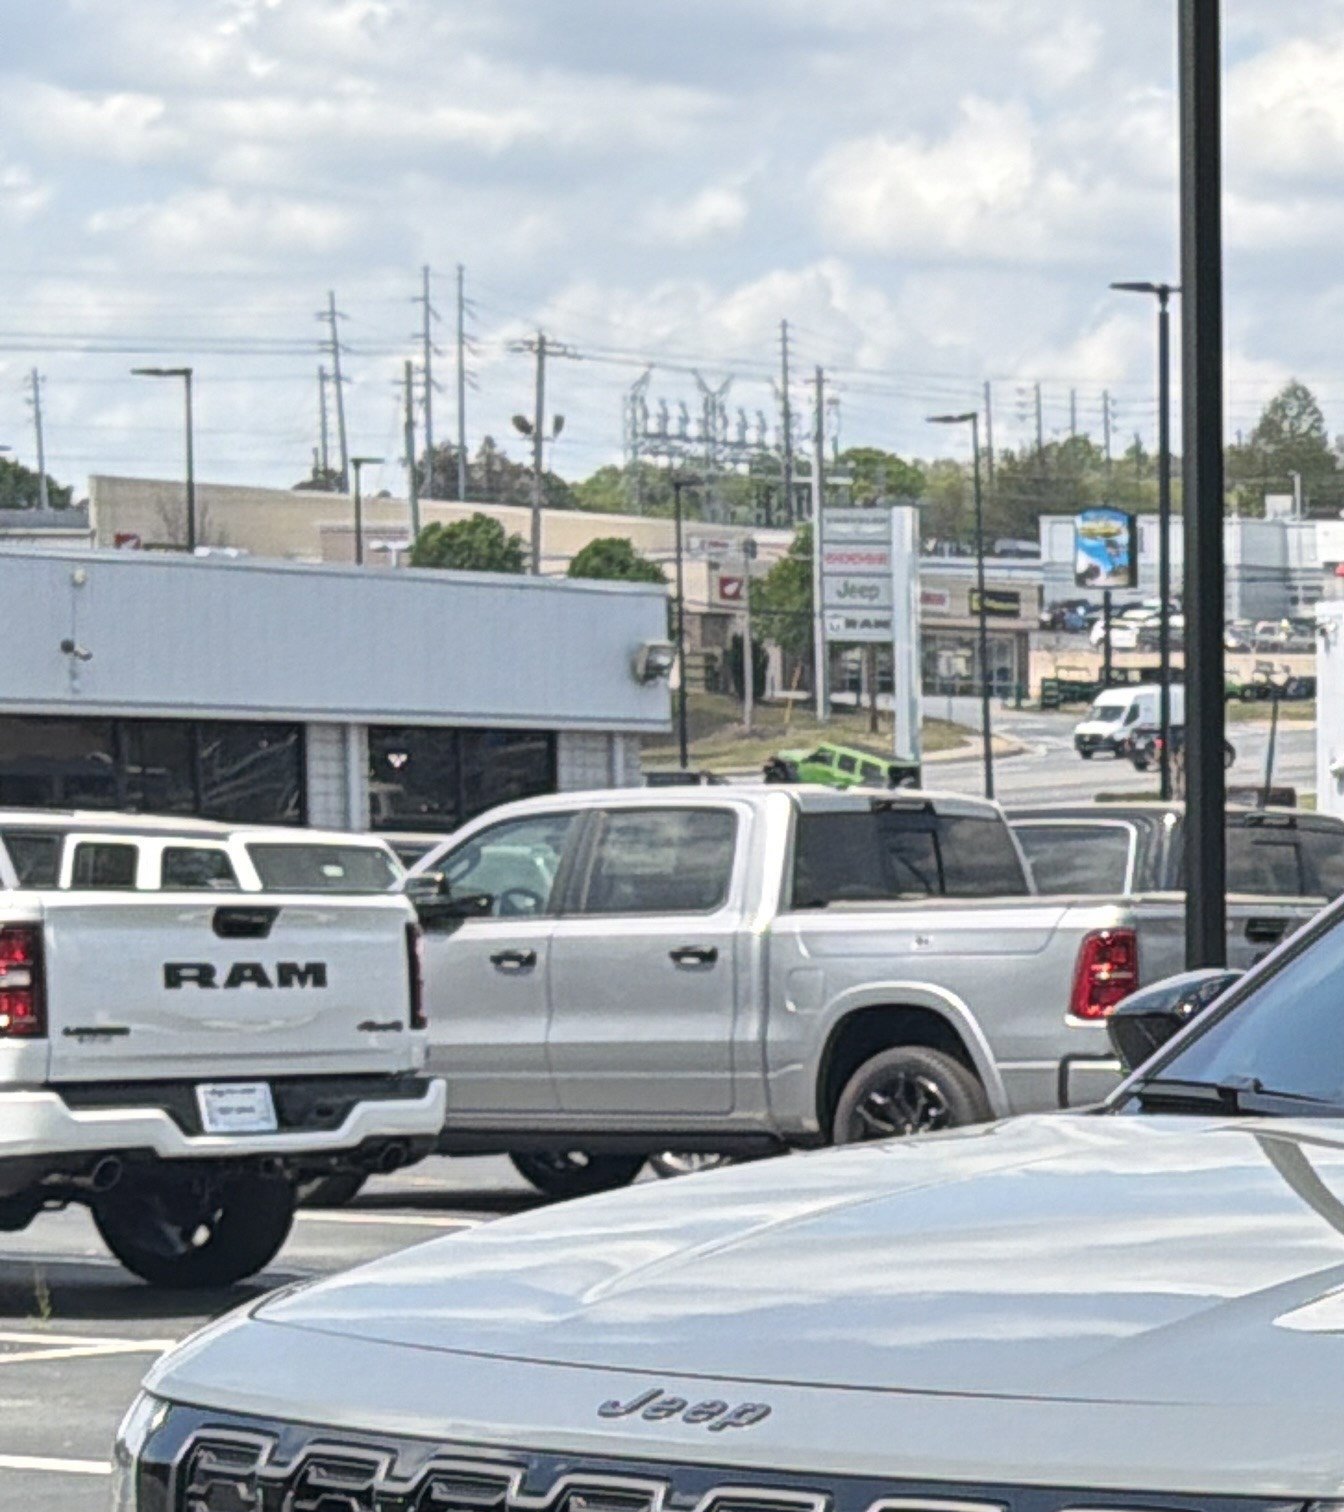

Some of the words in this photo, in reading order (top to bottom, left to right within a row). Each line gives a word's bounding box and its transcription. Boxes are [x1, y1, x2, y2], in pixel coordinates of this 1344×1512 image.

[836, 581, 880, 601] Jeep
[163, 962, 328, 989] RAM
[597, 1388, 772, 1432] Jeep
